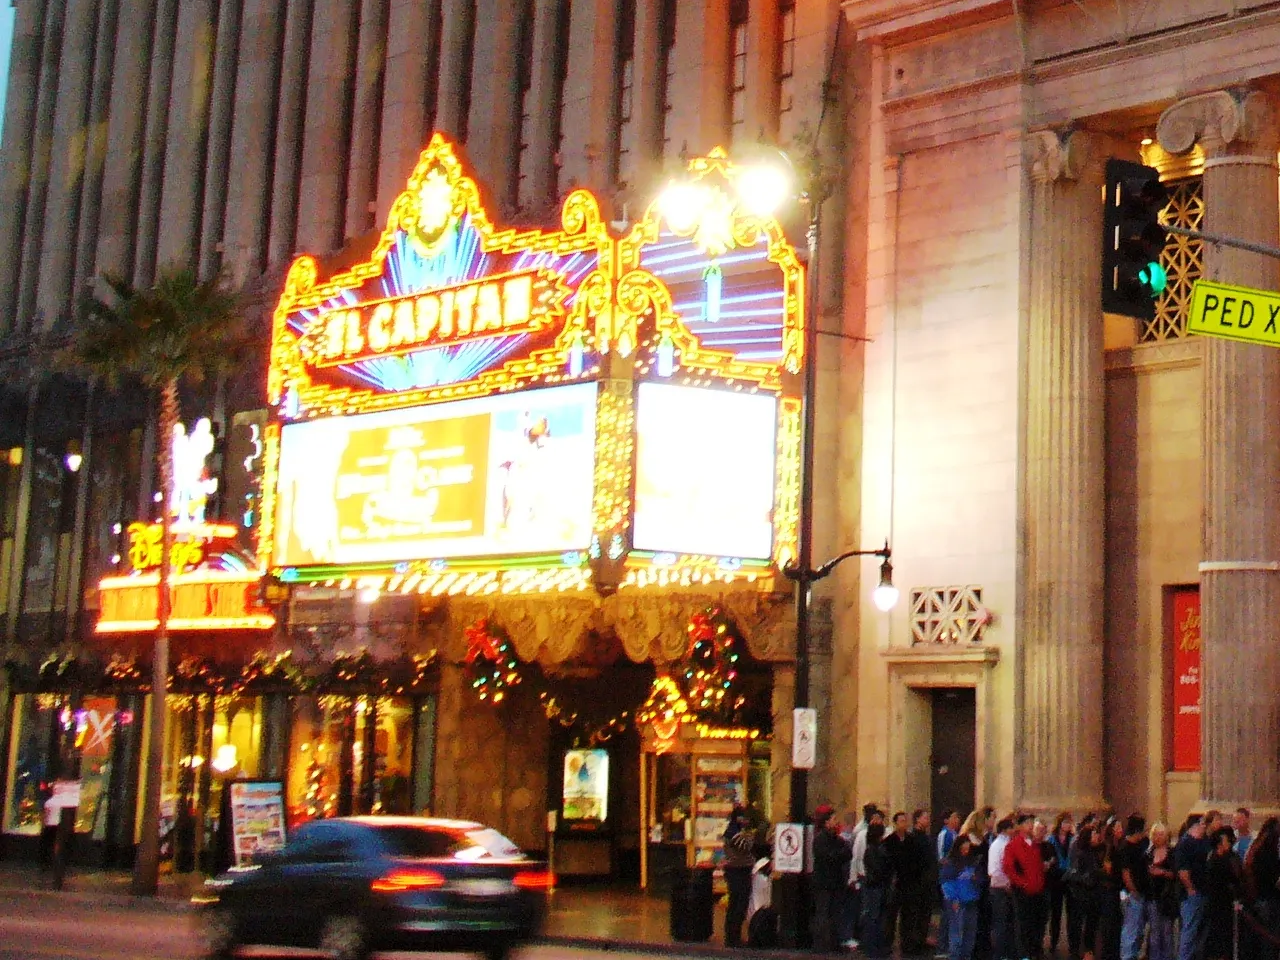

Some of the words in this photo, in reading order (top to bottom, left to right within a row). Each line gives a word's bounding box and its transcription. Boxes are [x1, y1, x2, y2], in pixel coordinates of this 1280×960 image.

[325, 310, 365, 359] EL
[367, 275, 533, 353] CAPITAN
[1201, 294, 1255, 329] PED
